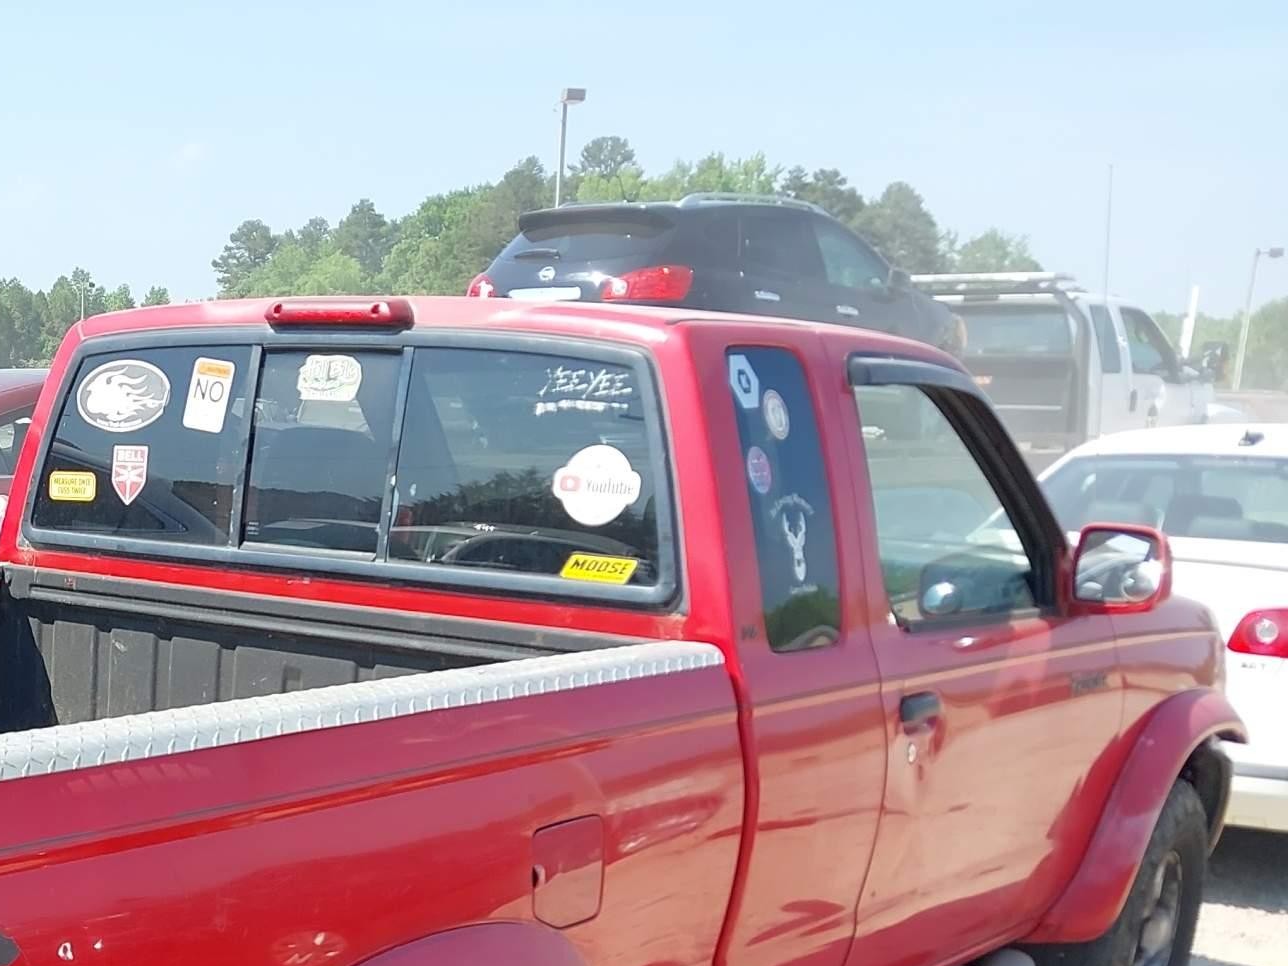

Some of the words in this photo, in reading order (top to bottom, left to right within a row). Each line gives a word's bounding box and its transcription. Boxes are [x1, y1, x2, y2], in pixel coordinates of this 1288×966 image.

[194, 378, 224, 403] NO
[116, 449, 145, 463] BELL
[570, 558, 631, 575] MOOSE
